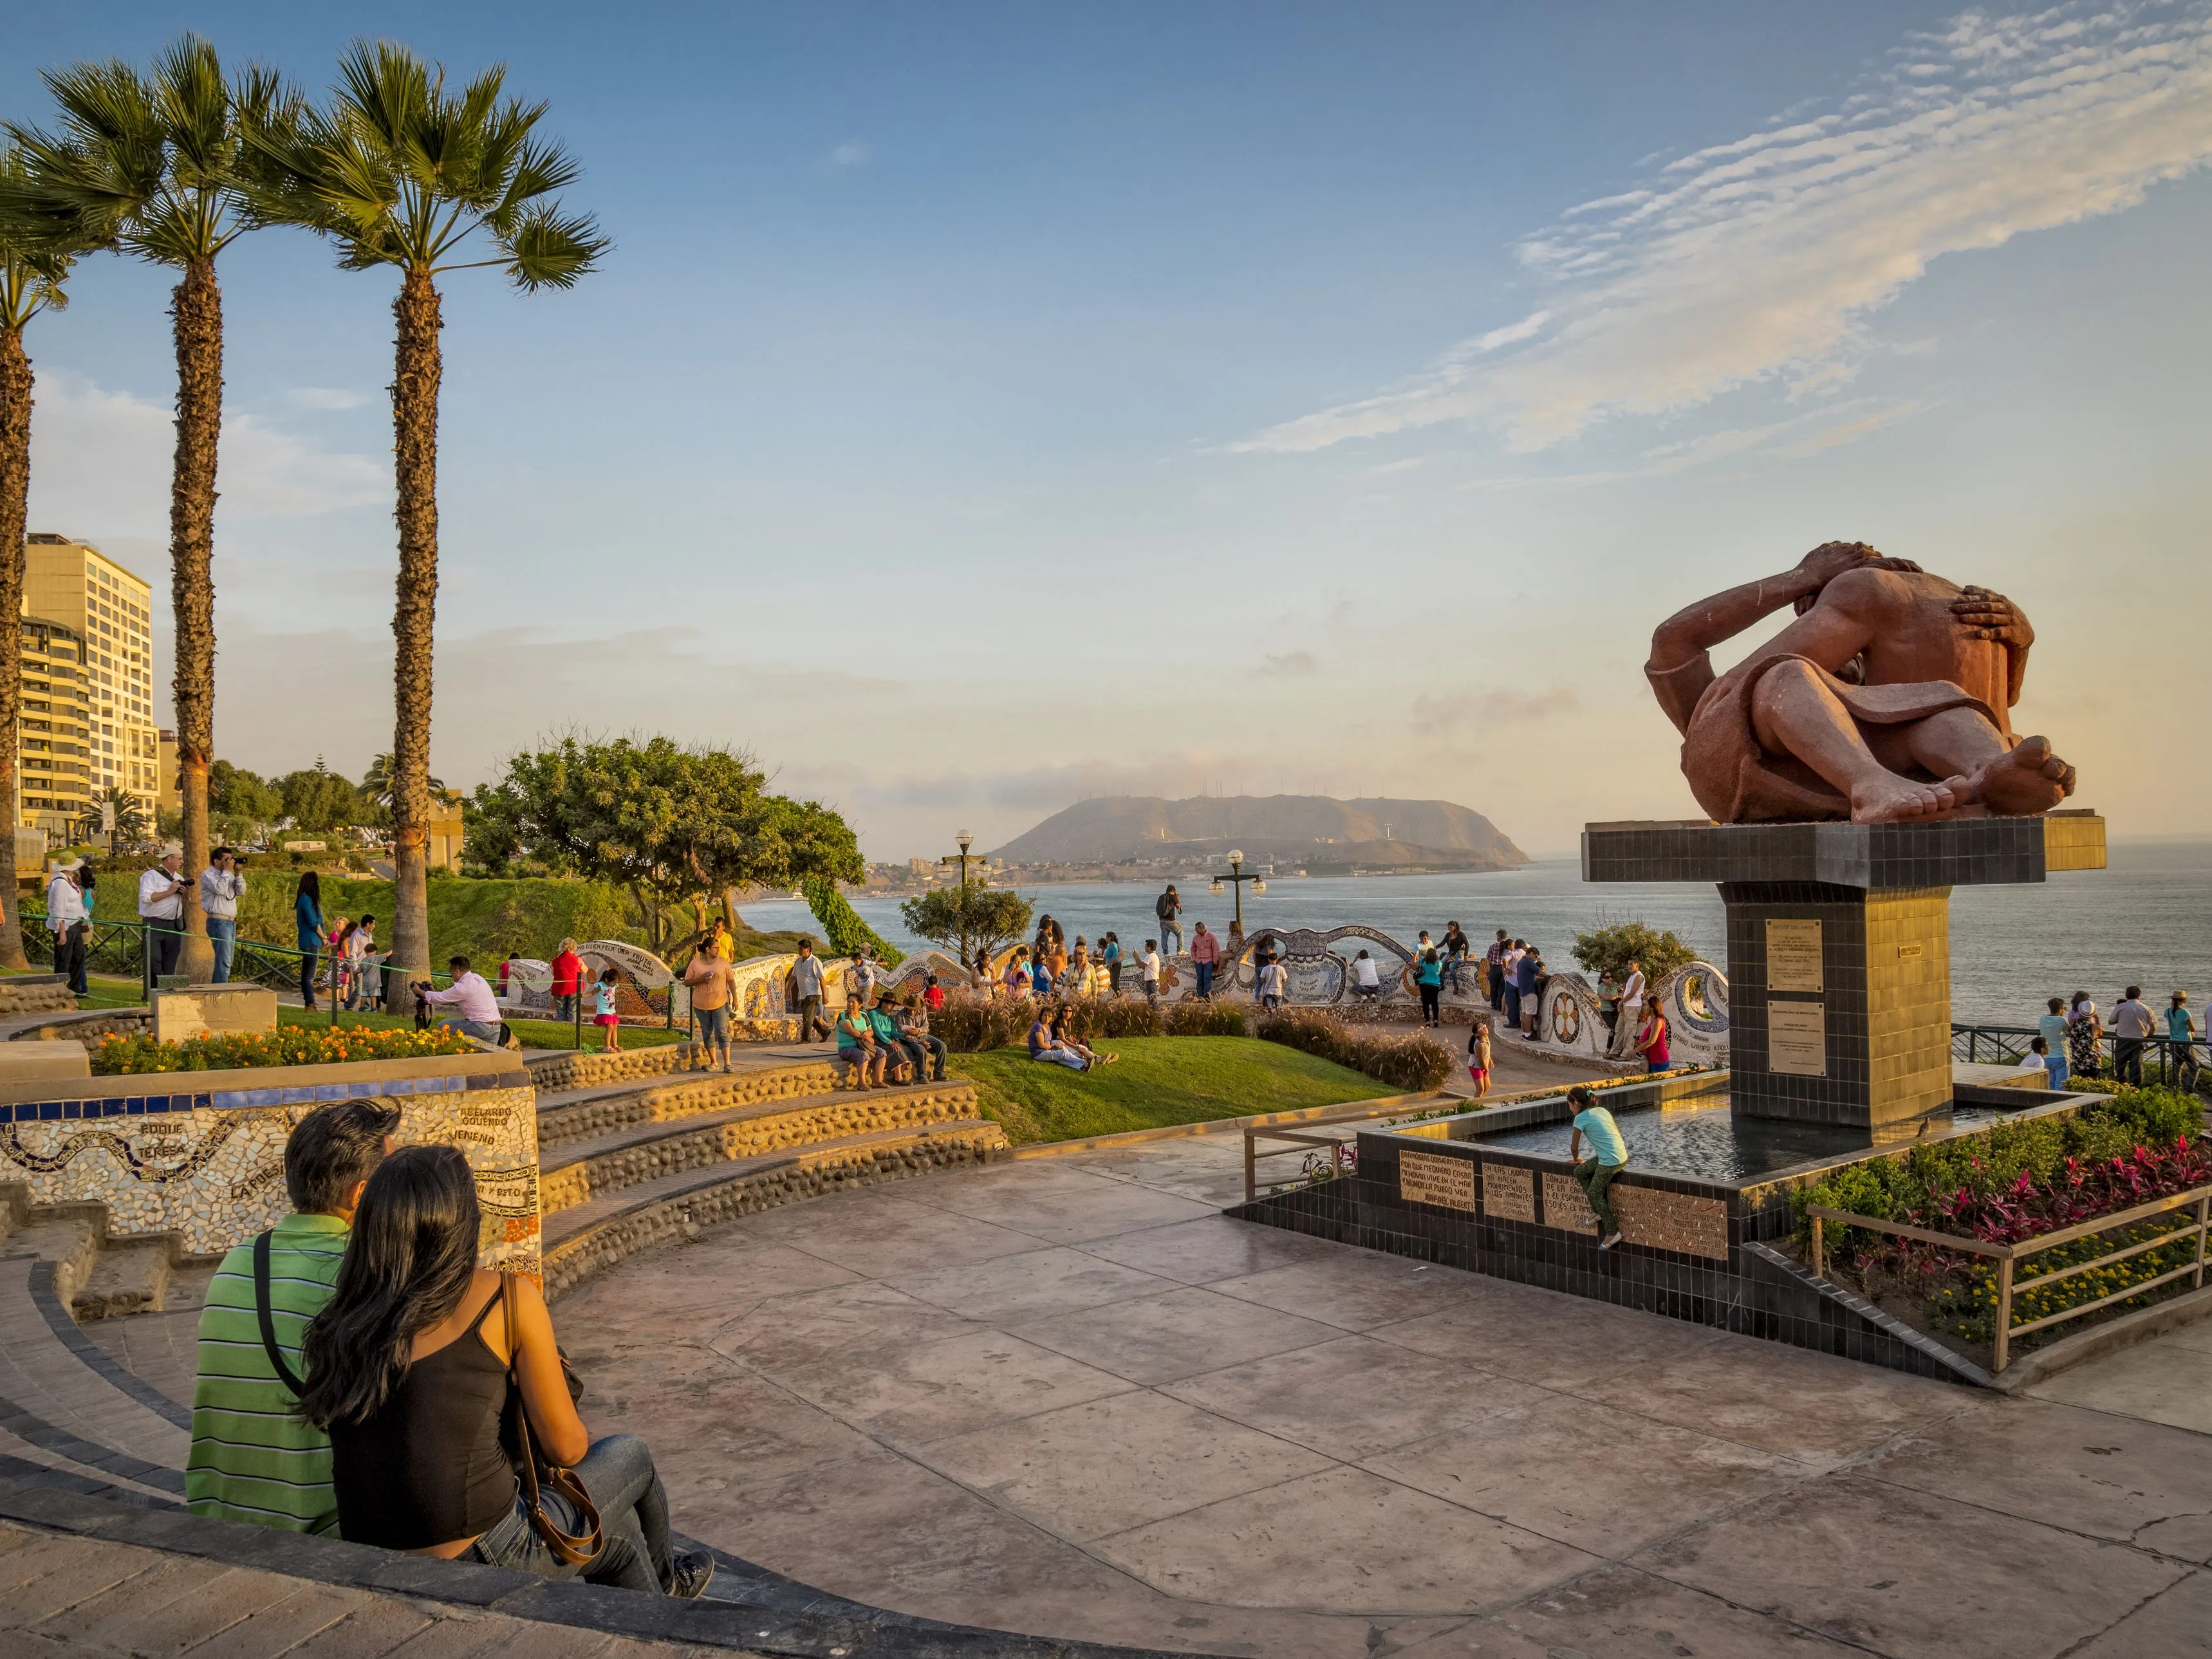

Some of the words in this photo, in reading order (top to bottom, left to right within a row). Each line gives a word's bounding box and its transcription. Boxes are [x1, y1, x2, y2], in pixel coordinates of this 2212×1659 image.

[632, 952, 652, 966] FRUTA
[882, 978, 898, 987] CUANDO
[460, 1108, 512, 1117] ABELARDO
[463, 1117, 507, 1126] OQUENDO
[139, 1147, 186, 1158] TERESA
[1430, 1155, 1454, 1165] QUISIERA
[1454, 1160, 1473, 1169] TENER
[1412, 1162, 1423, 1171] QUE
[1453, 1170, 1472, 1180] CASAR
[1494, 1166, 1505, 1175] LAS
[1508, 1168, 1532, 1179] CIUDADES
[1408, 1172, 1426, 1180] NOVIA
[1427, 1174, 1440, 1183] VIVE
[1498, 1176, 1517, 1184] HACEN
[232, 1187, 251, 1198] LA
[497, 1189, 521, 1197] BETO
[1434, 1184, 1453, 1194] PUEDO
[1455, 1189, 1468, 1197] VER
[1487, 1182, 1527, 1194] MONUMENTOS
[1547, 1183, 1555, 1191] DE
[1570, 1186, 1585, 1195] CAR
[1425, 1193, 1449, 1205] RAFAEL
[1449, 1199, 1474, 1210] ALBERTI
[1491, 1189, 1503, 1198] LOS
[1505, 1191, 1533, 1202] AMANTES
[1561, 1193, 1589, 1205] ESPIRITU
[1506, 1200, 1528, 1210] ANTONIO
[1545, 1199, 1557, 1209] ESO
[1559, 1201, 1567, 1210] ES
[1570, 1203, 1577, 1212] EL
